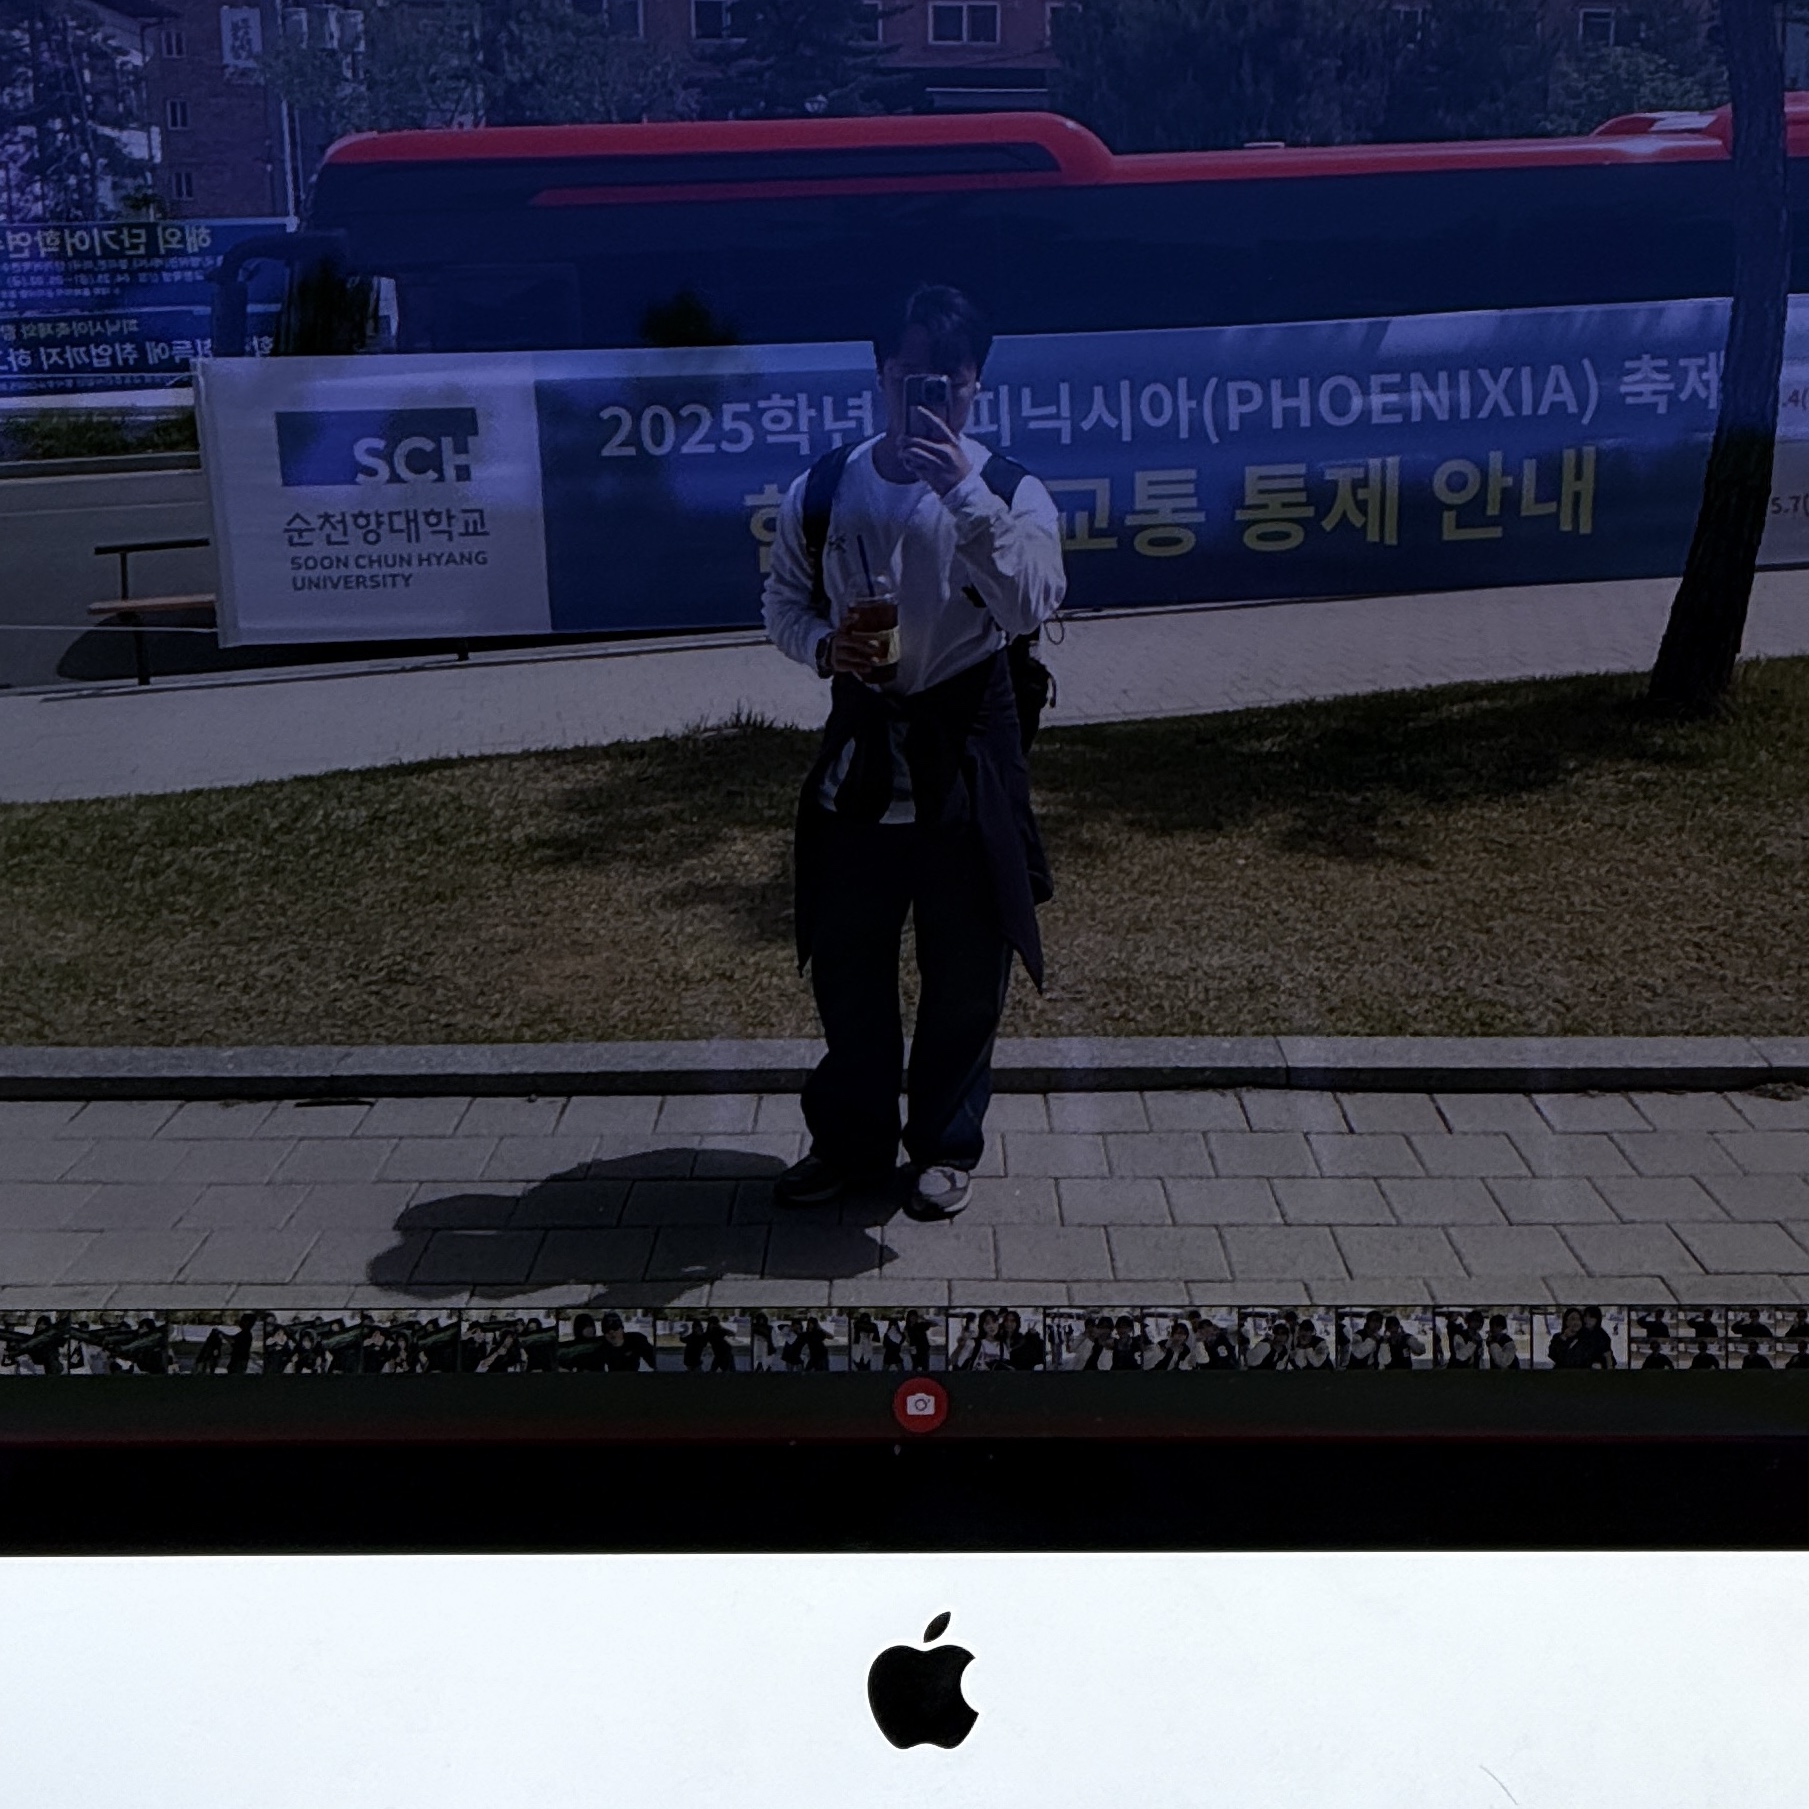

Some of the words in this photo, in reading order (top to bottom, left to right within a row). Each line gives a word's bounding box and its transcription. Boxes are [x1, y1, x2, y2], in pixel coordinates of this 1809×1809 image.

[353, 436, 477, 485] SCH
[1044, 467, 1207, 557] 교통
[1234, 455, 1400, 554] 통제
[1432, 445, 1597, 543] 안내
[283, 508, 490, 546] 순천향대학교
[290, 556, 349, 571] SOON
[355, 554, 412, 569] CHUN
[418, 550, 488, 567] HYANG
[293, 573, 413, 591] UNIVERSITY
